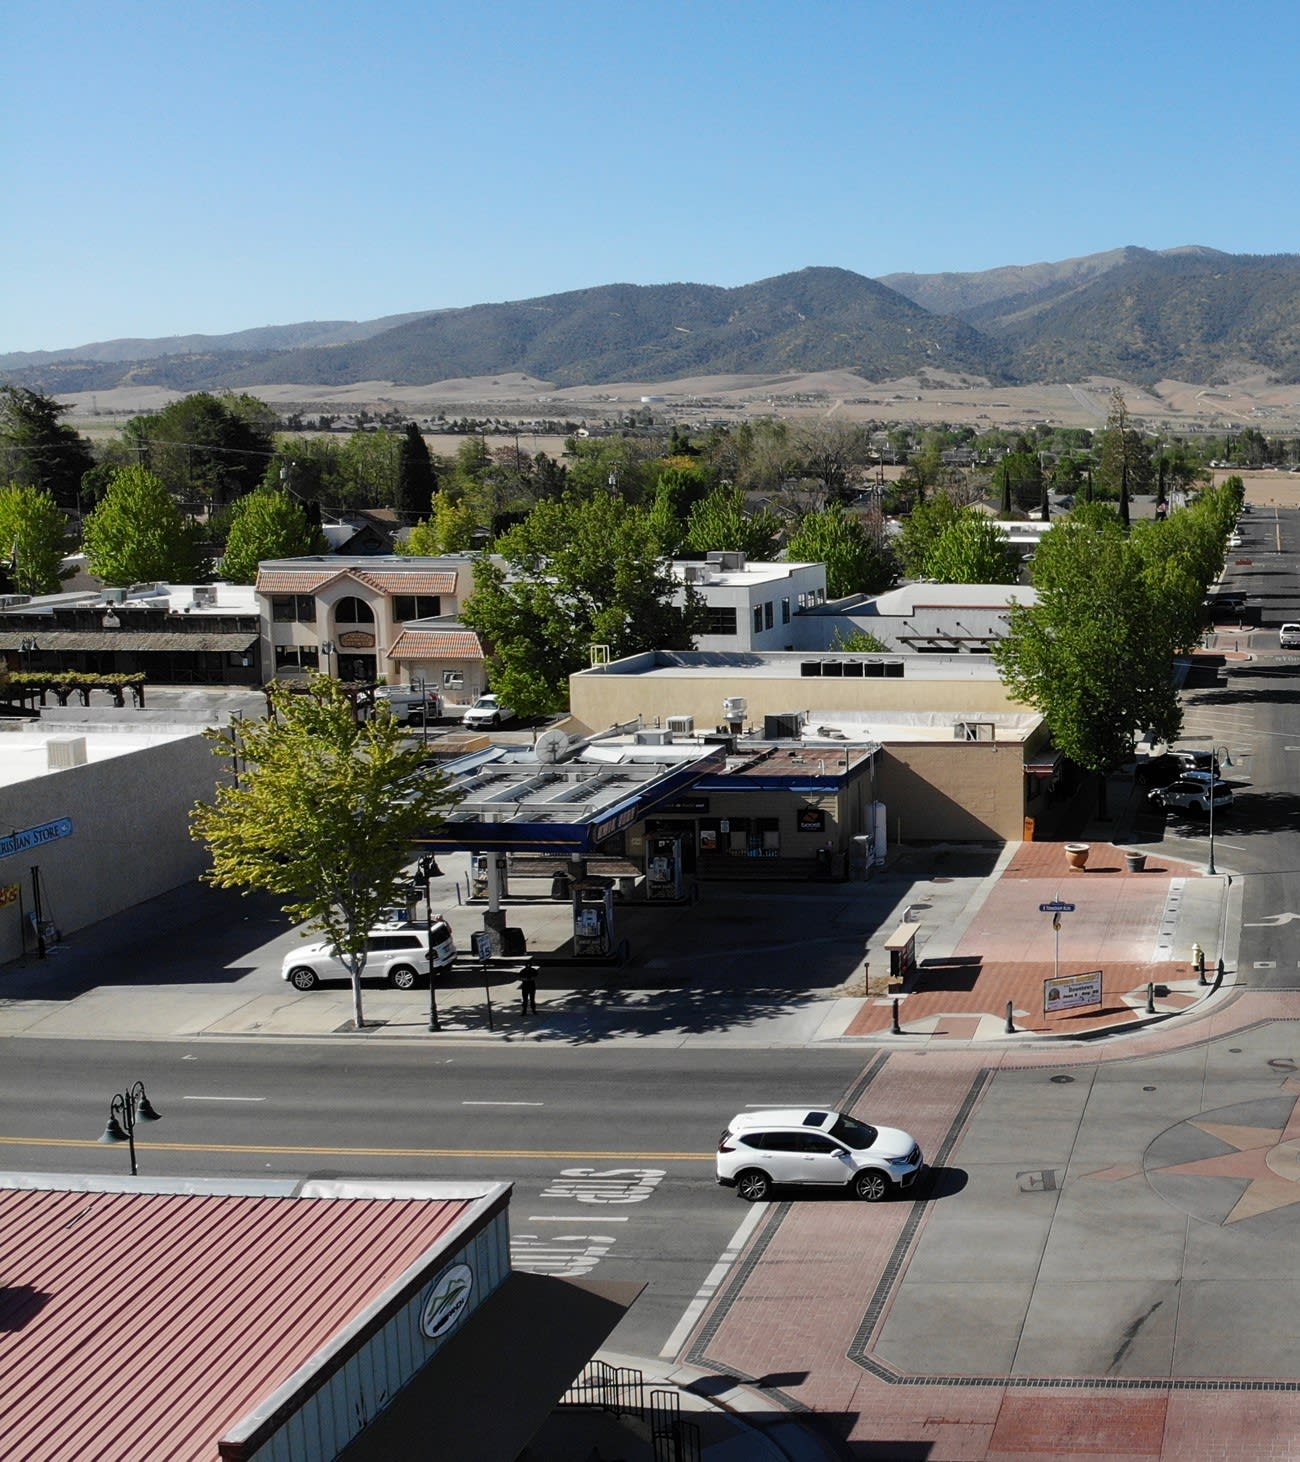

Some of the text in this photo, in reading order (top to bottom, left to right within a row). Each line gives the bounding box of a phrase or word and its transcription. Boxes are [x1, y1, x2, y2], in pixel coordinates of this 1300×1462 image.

[1, 825, 60, 854] RISTIAN STORE
[1267, 1057, 1299, 1073] S
[538, 1168, 667, 1204] STOP
[1016, 1169, 1062, 1193] E
